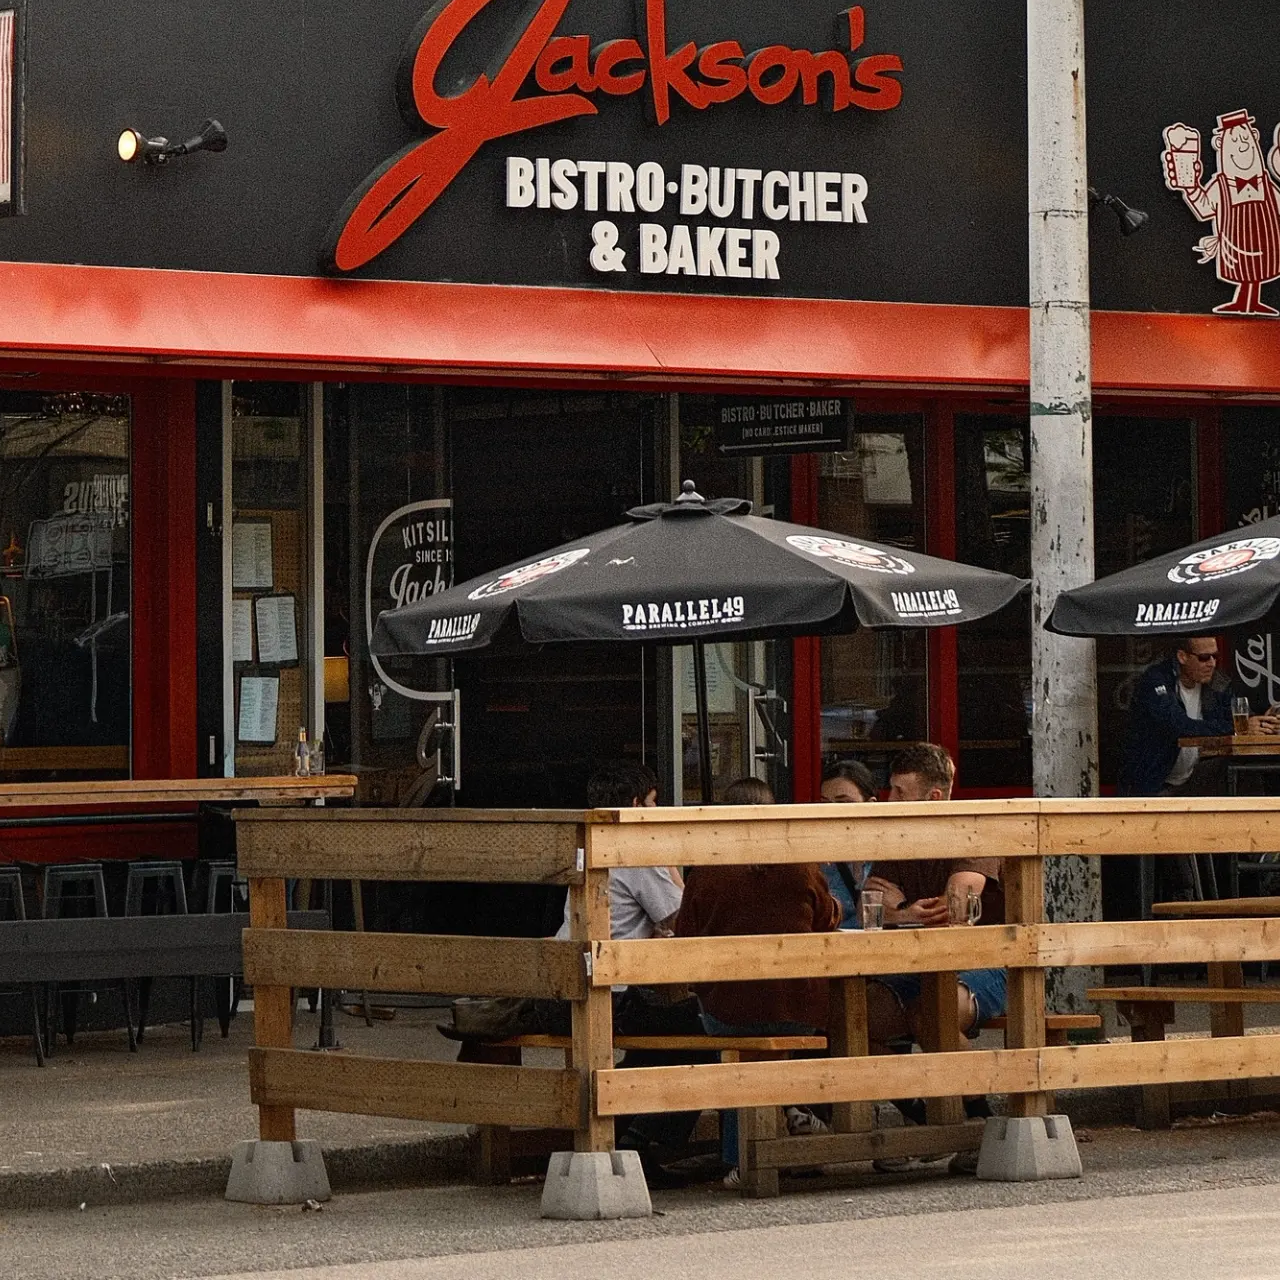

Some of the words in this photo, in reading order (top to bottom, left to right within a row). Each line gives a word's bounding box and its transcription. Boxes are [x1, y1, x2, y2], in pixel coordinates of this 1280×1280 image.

[590, 220, 627, 272] &
[639, 225, 781, 280] BAKER
[415, 550, 443, 563] SINCE
[688, 618, 719, 628] COMPANY
